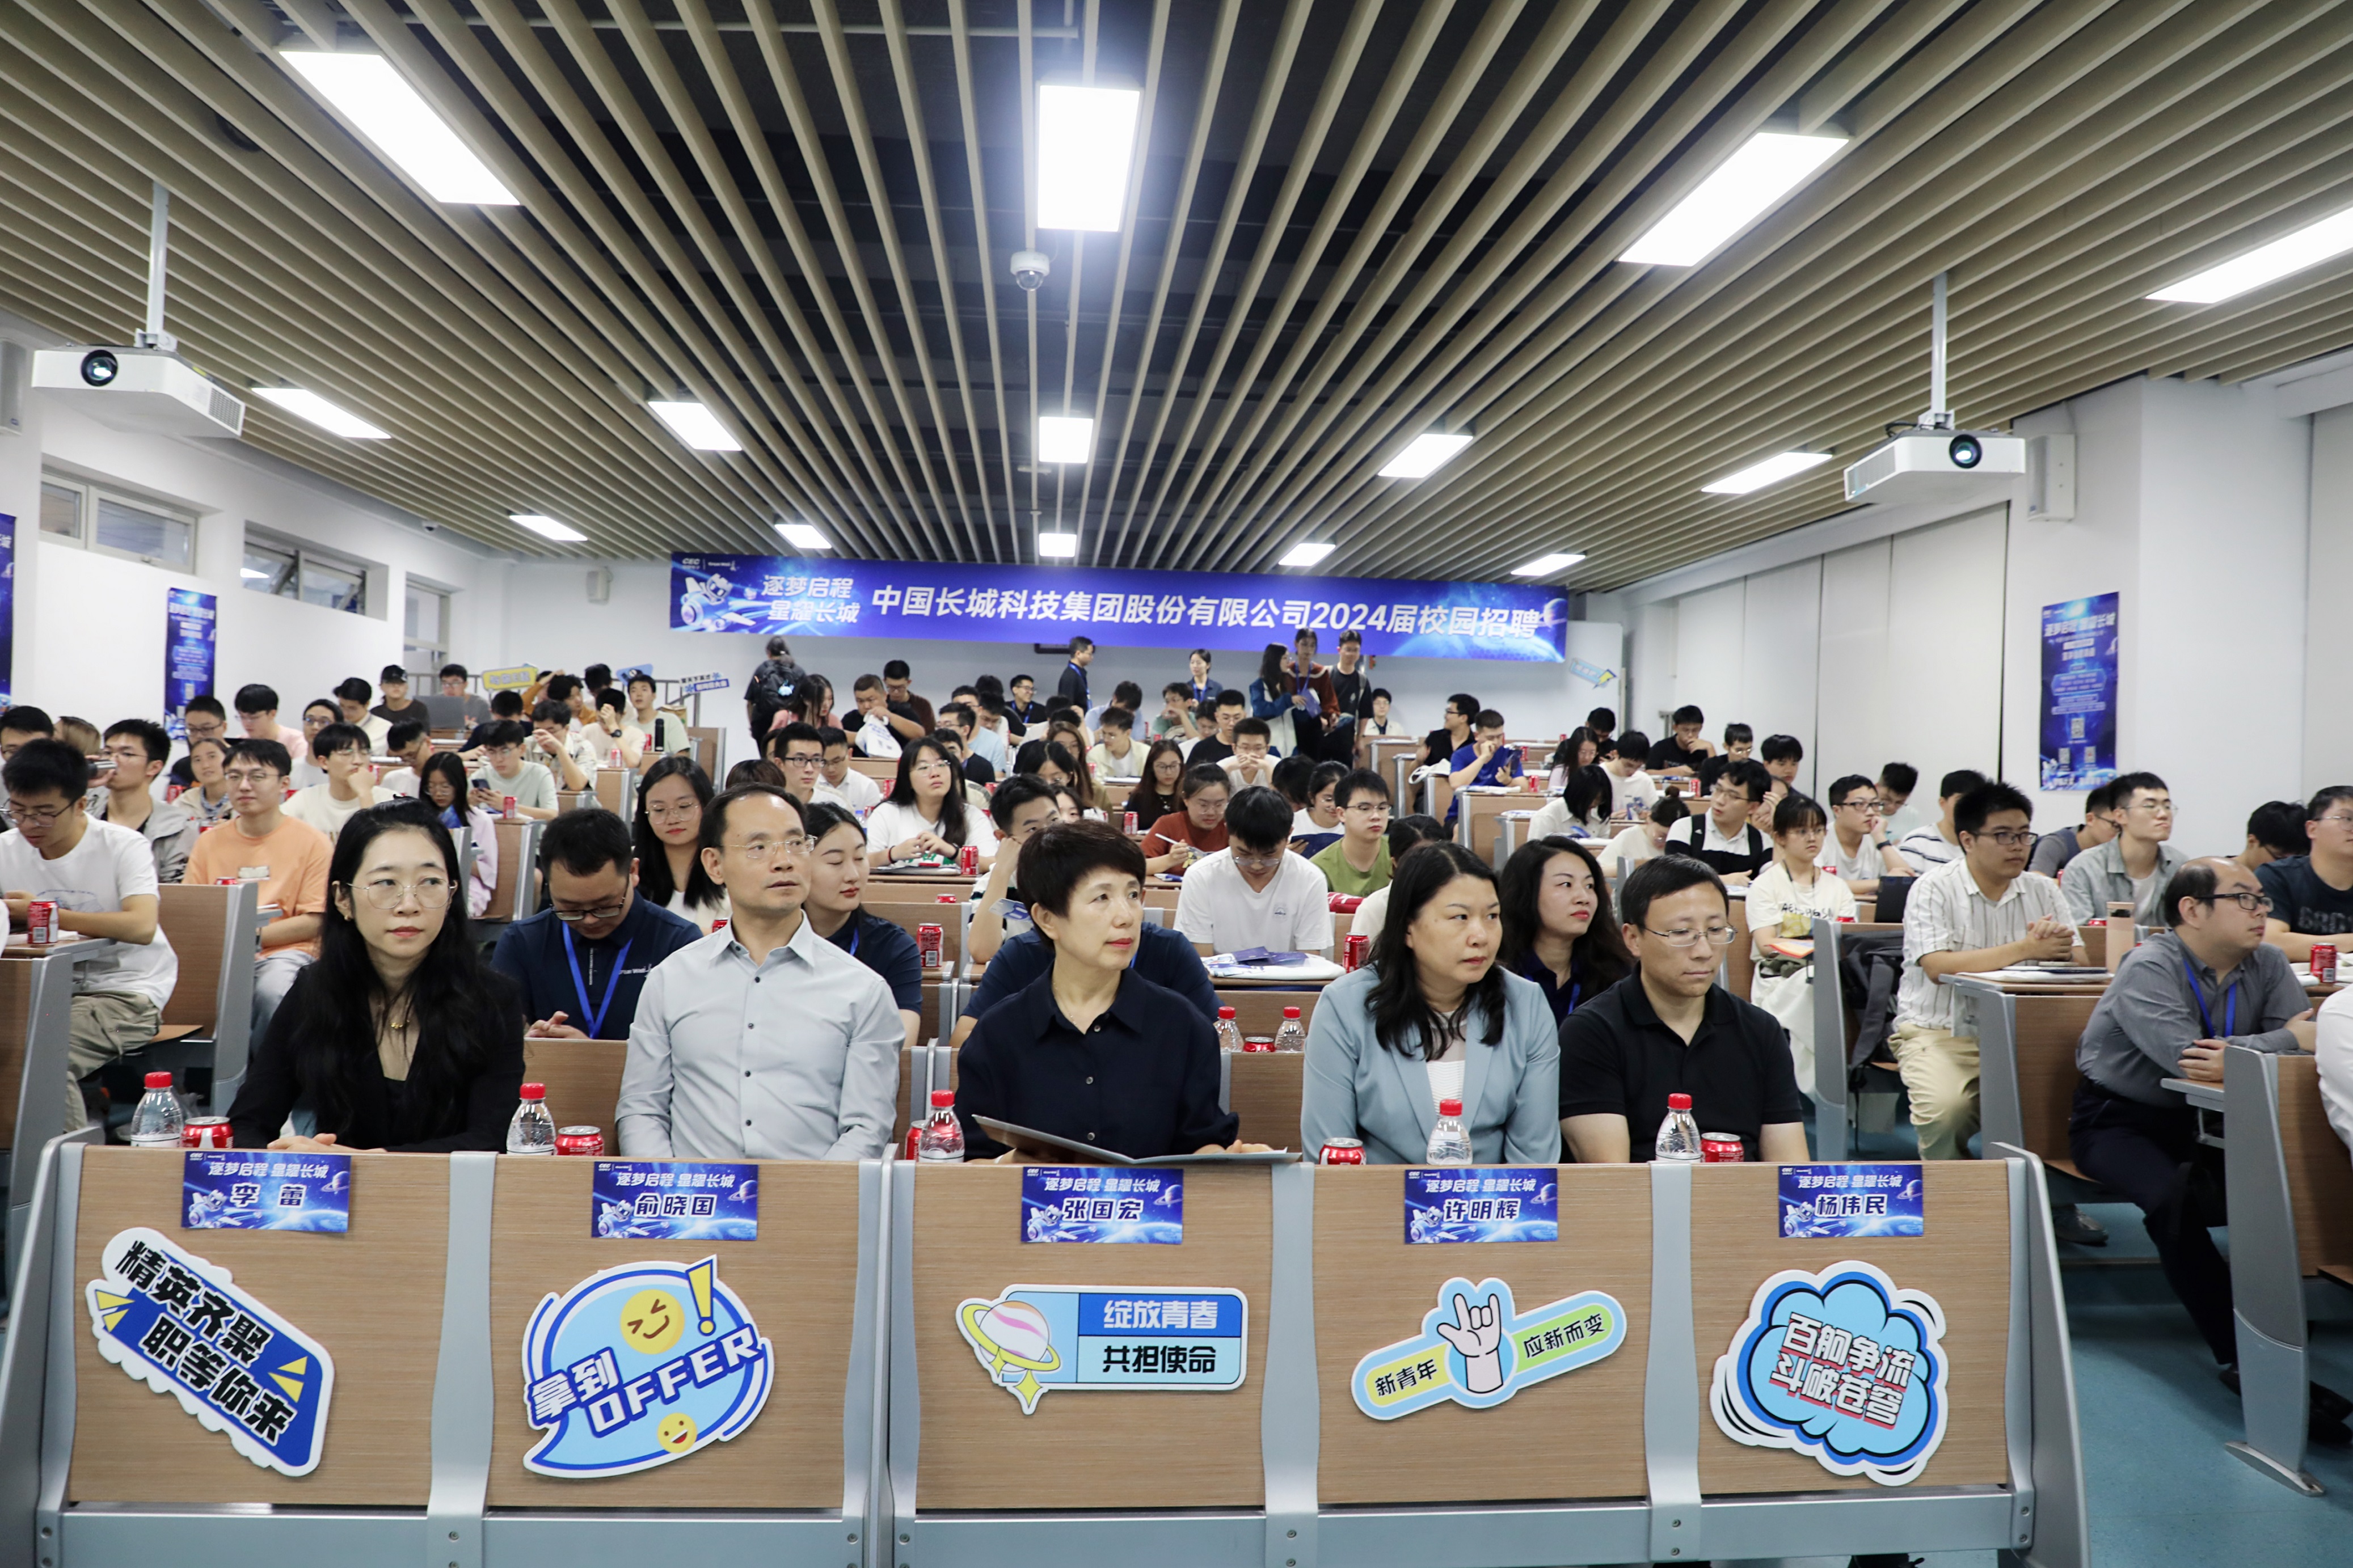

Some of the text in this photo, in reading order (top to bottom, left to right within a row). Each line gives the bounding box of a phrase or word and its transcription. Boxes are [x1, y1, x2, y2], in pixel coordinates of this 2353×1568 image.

[761, 574, 854, 599] 逐梦启程
[767, 599, 861, 623] 星耀长城
[871, 584, 1540, 639] 中国长城科技集团股份有限公司2024届校园招聘
[208, 1161, 330, 1178] 逐梦启程 星耀长城
[615, 1172, 736, 1188] 逐梦启程 星耀长城
[1798, 1174, 1903, 1189] 逐梦启程 星耀长城
[231, 1184, 305, 1207] 李 蕾
[1044, 1177, 1161, 1193] 逐梦启程 星耀长城
[1426, 1178, 1537, 1193] 逐梦启程 星耀长城
[635, 1194, 715, 1217] 俞晓国
[1062, 1199, 1142, 1221] 张国宏
[1445, 1199, 1520, 1220] 许明辉
[1815, 1195, 1887, 1216] 杨伟民
[115, 1240, 272, 1363] 精英齐聚
[1103, 1300, 1218, 1329] 绽放青春
[1103, 1345, 1216, 1374] 共担使命
[1374, 1312, 1606, 1397] 新青年 应新而变
[1781, 1312, 1916, 1390] 百舸争流
[142, 1316, 295, 1442] 职等你来
[532, 1349, 619, 1421] 拿到
[588, 1326, 758, 1432] OFFER
[1770, 1350, 1904, 1427] 斗破苍穹
